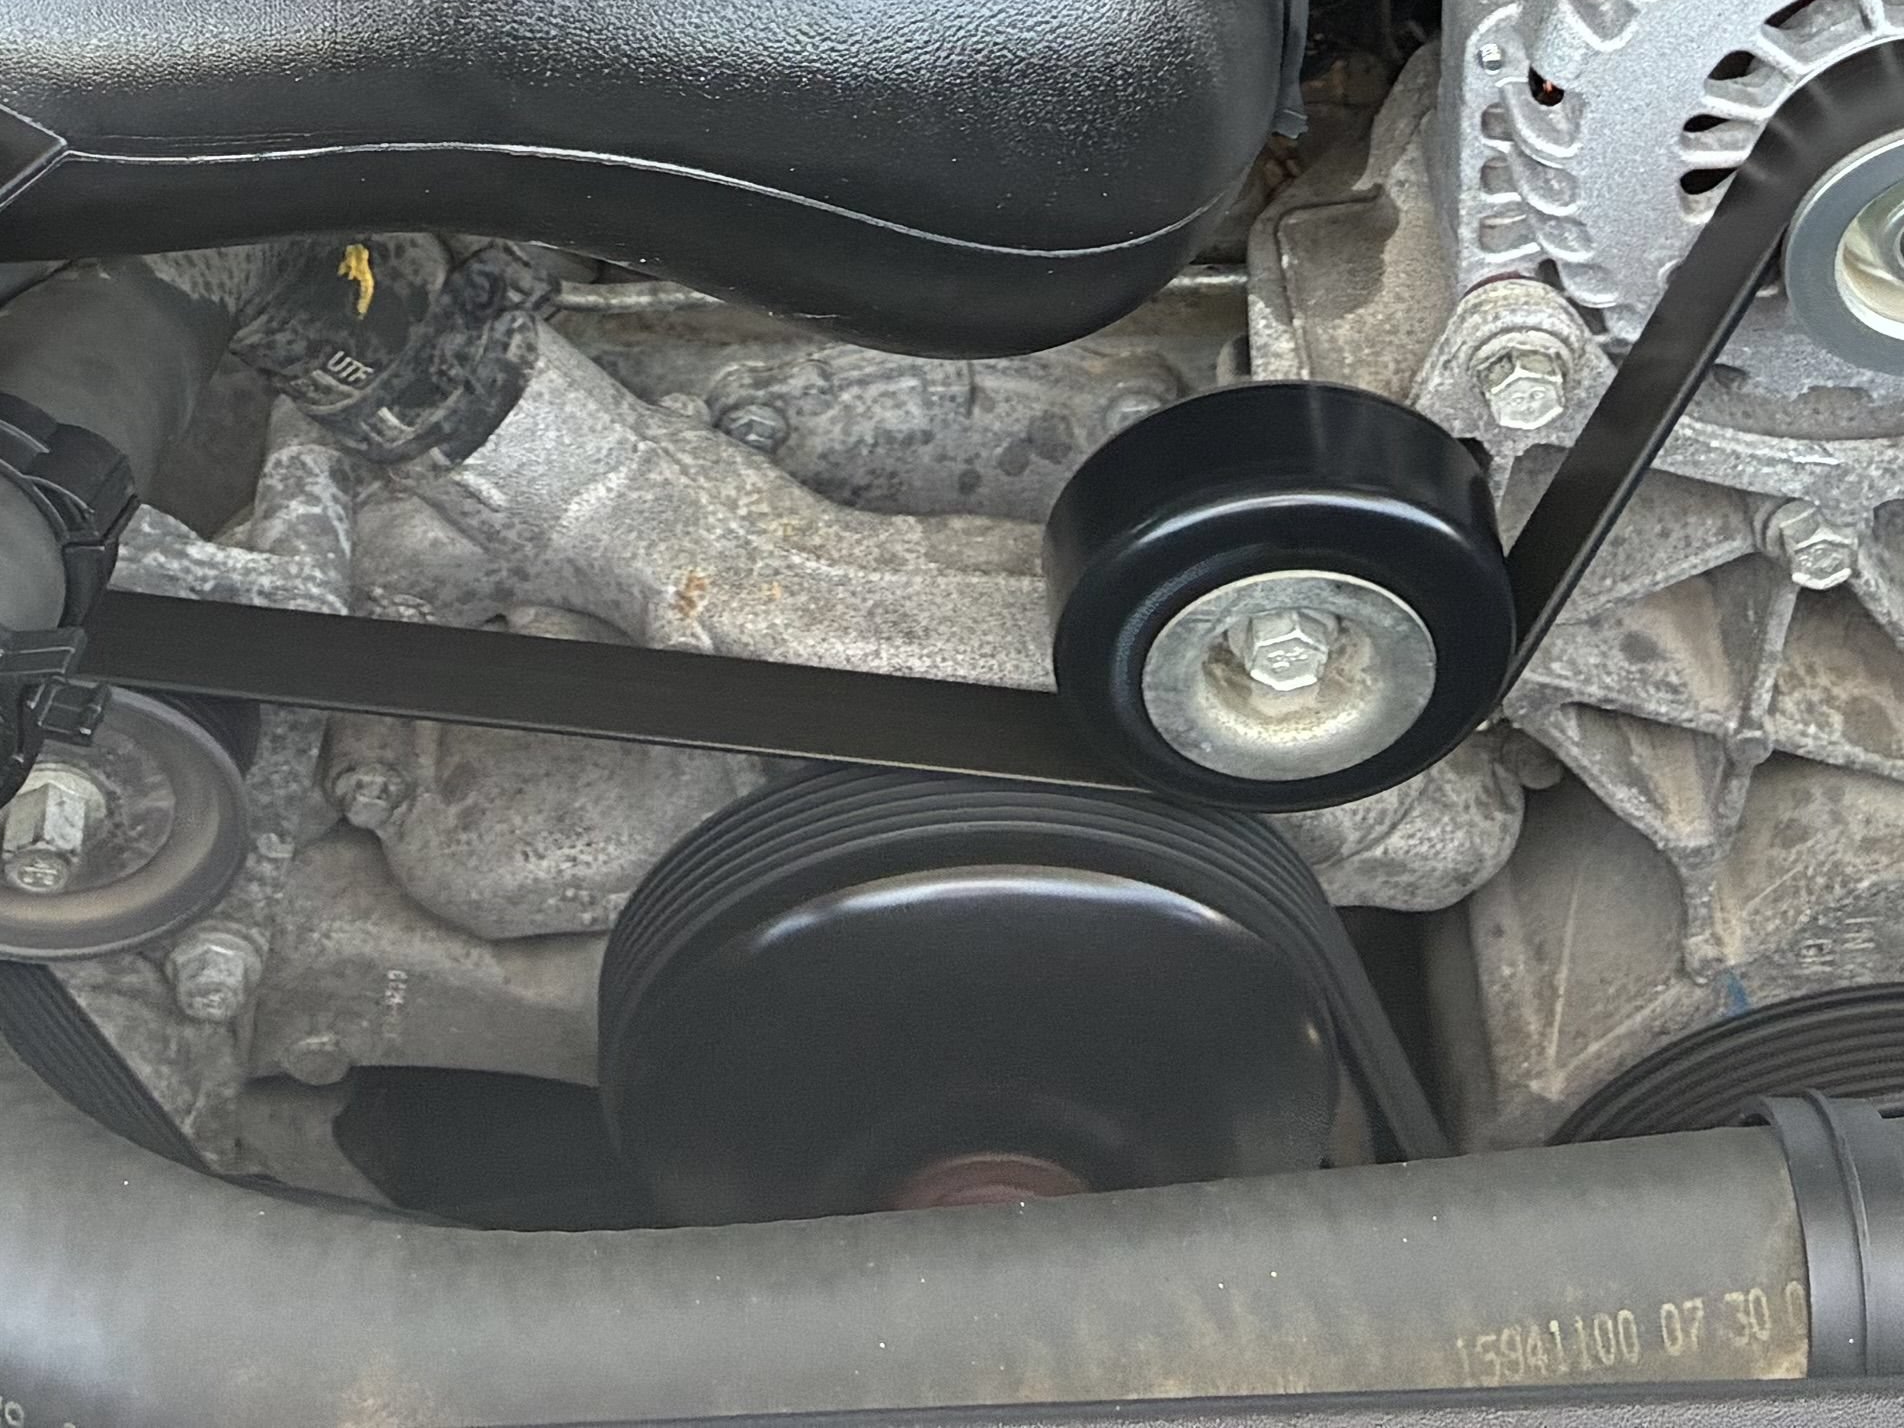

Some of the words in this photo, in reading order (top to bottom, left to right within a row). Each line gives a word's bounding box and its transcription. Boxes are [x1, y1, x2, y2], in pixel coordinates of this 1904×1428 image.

[327, 350, 374, 388] UTF
[1453, 1308, 1640, 1385] 15941100
[1660, 1297, 1706, 1358] 07
[1727, 1286, 1772, 1348] 30
